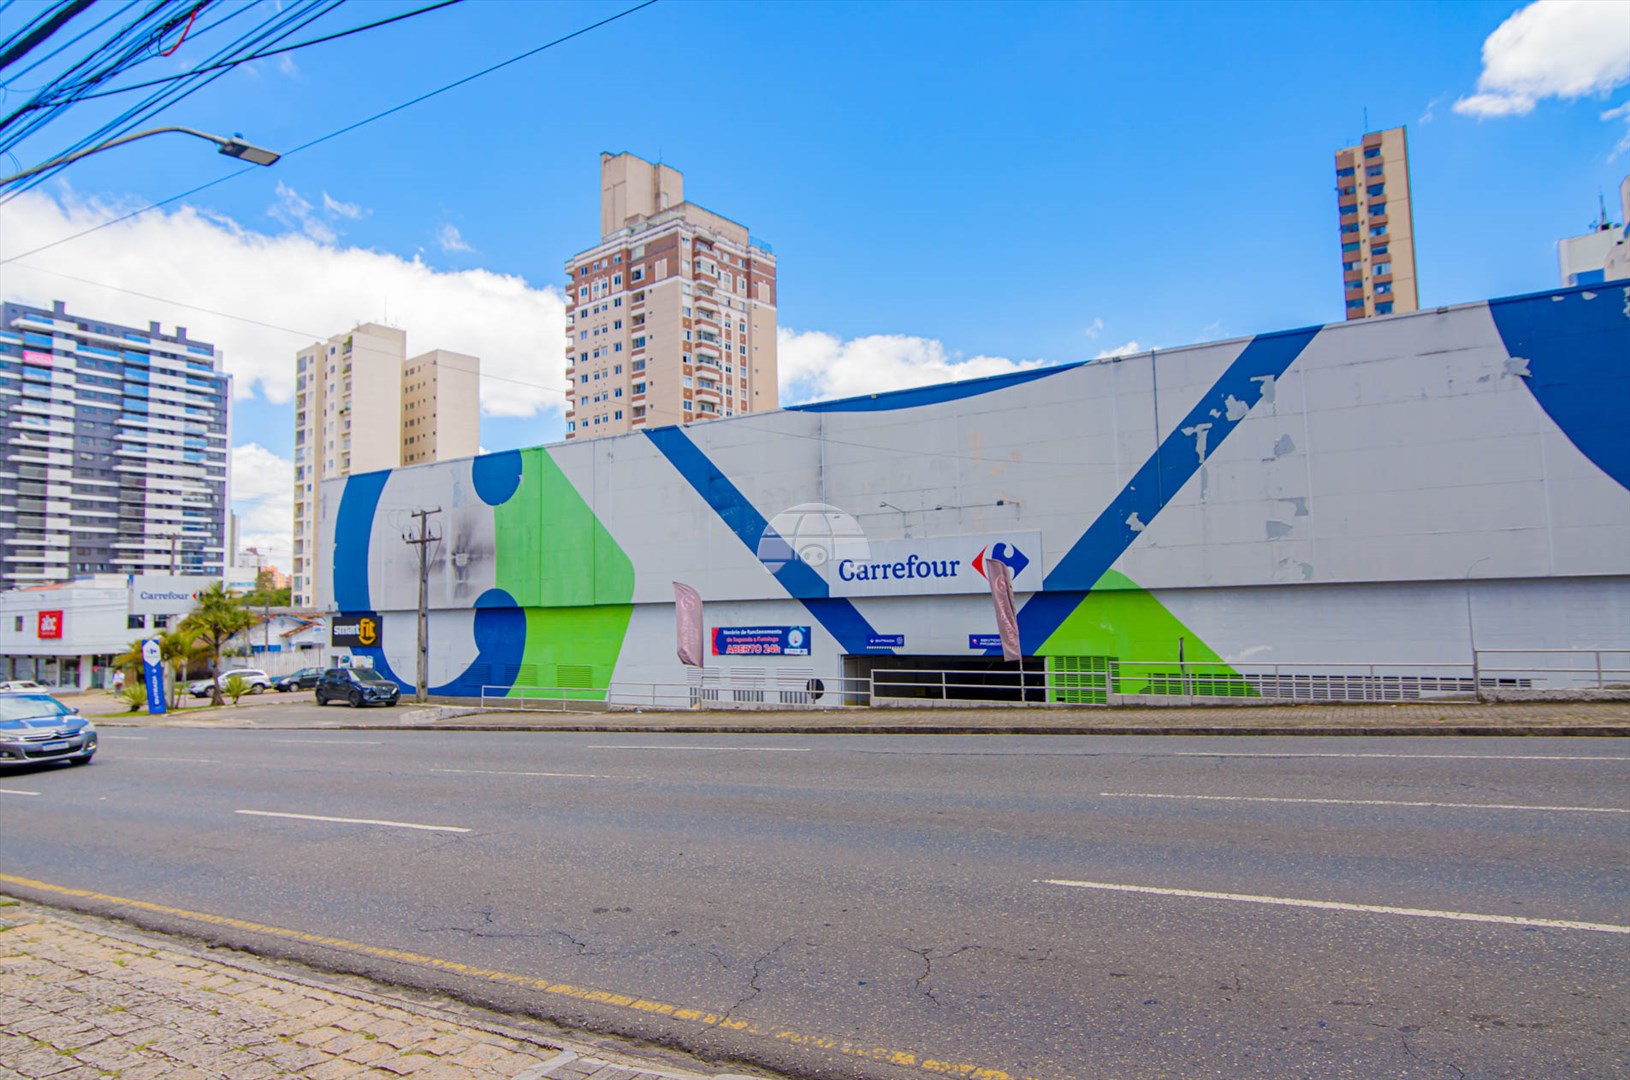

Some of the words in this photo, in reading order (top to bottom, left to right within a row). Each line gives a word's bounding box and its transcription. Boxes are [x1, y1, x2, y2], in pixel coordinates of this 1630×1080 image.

[838, 554, 960, 581] Carrefour
[140, 591, 189, 600] Carrefour
[334, 624, 360, 635] smart
[359, 618, 376, 645] fit
[726, 644, 762, 654] ABERTO
[763, 644, 781, 654] 24h
